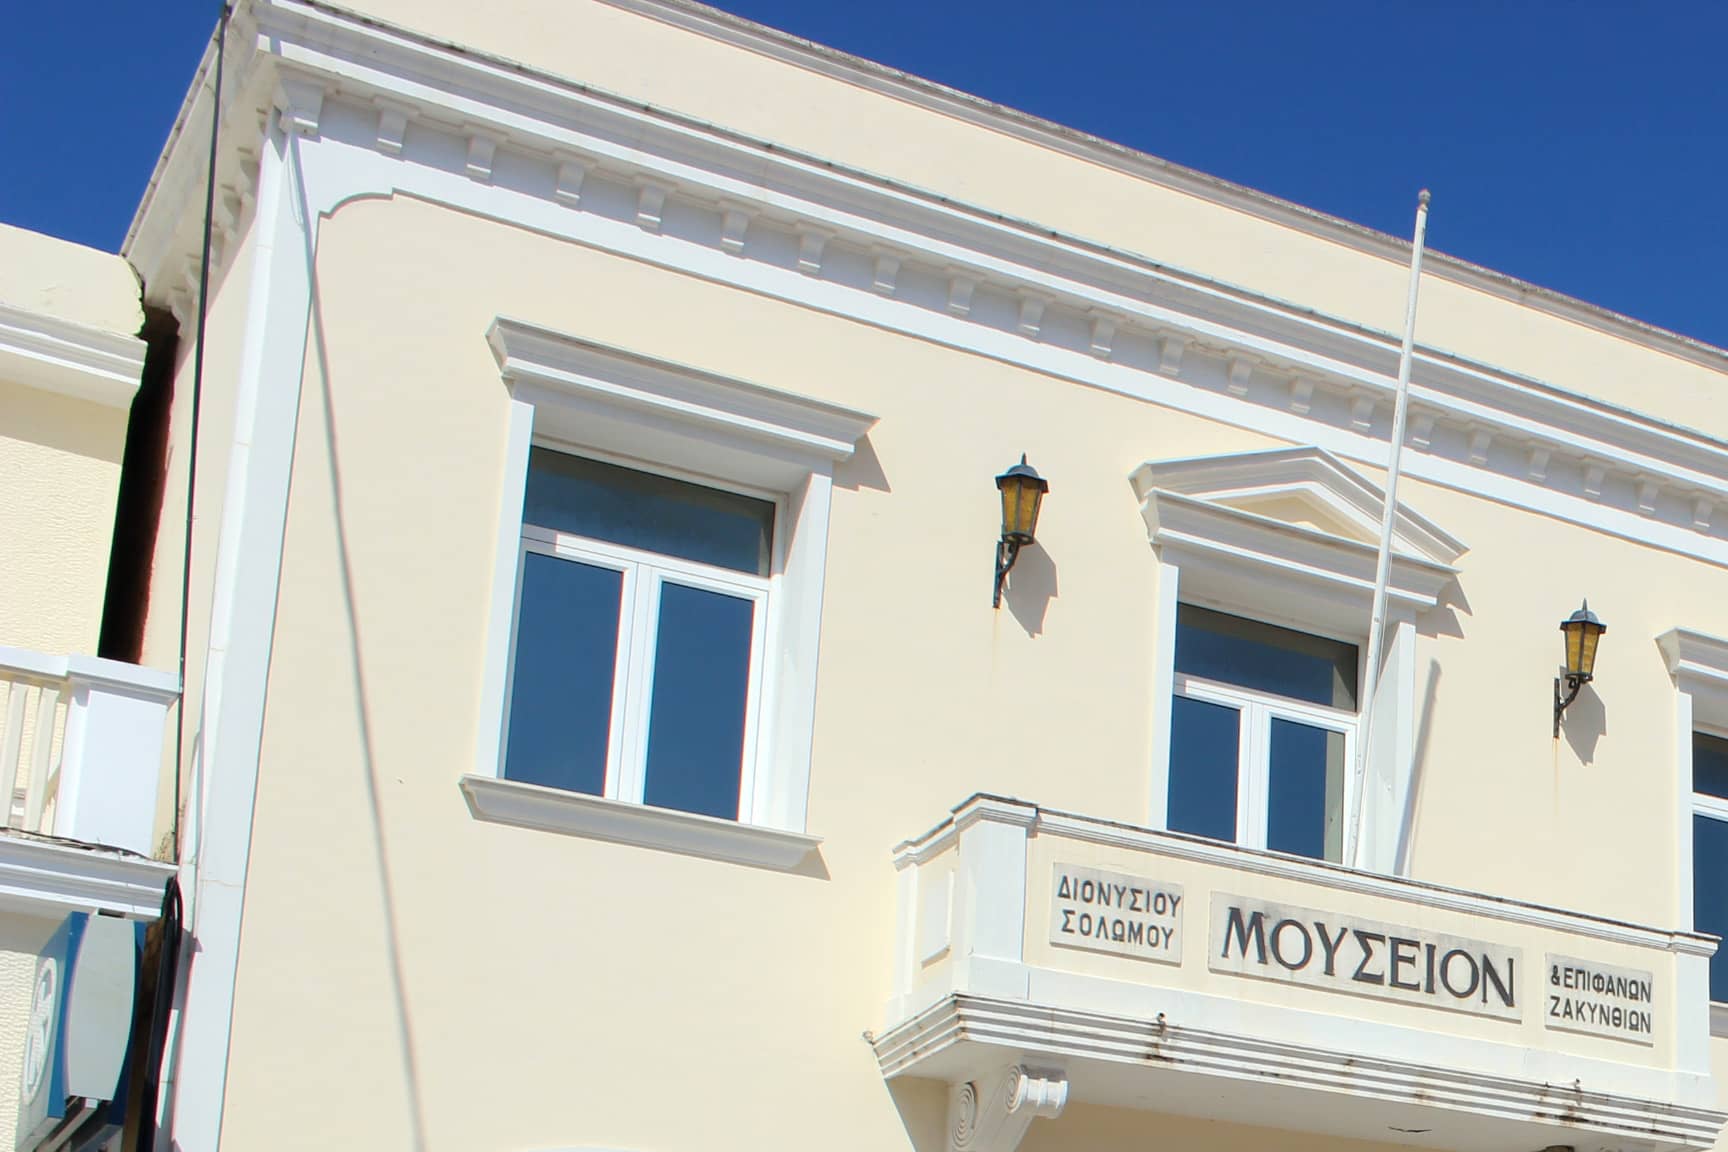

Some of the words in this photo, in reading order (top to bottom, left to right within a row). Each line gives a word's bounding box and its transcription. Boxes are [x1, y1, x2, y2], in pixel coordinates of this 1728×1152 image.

[1057, 875, 1181, 918] ΔΙΟΝΥΣΙΟΥ
[1061, 908, 1174, 950] ΣΟΛΩΜΟΥ
[1221, 906, 1515, 1008] ΜΟΥΣΕΙΟΝ
[1550, 995, 1651, 1034] ΖΑΚΥΝΘΙΩΝ
